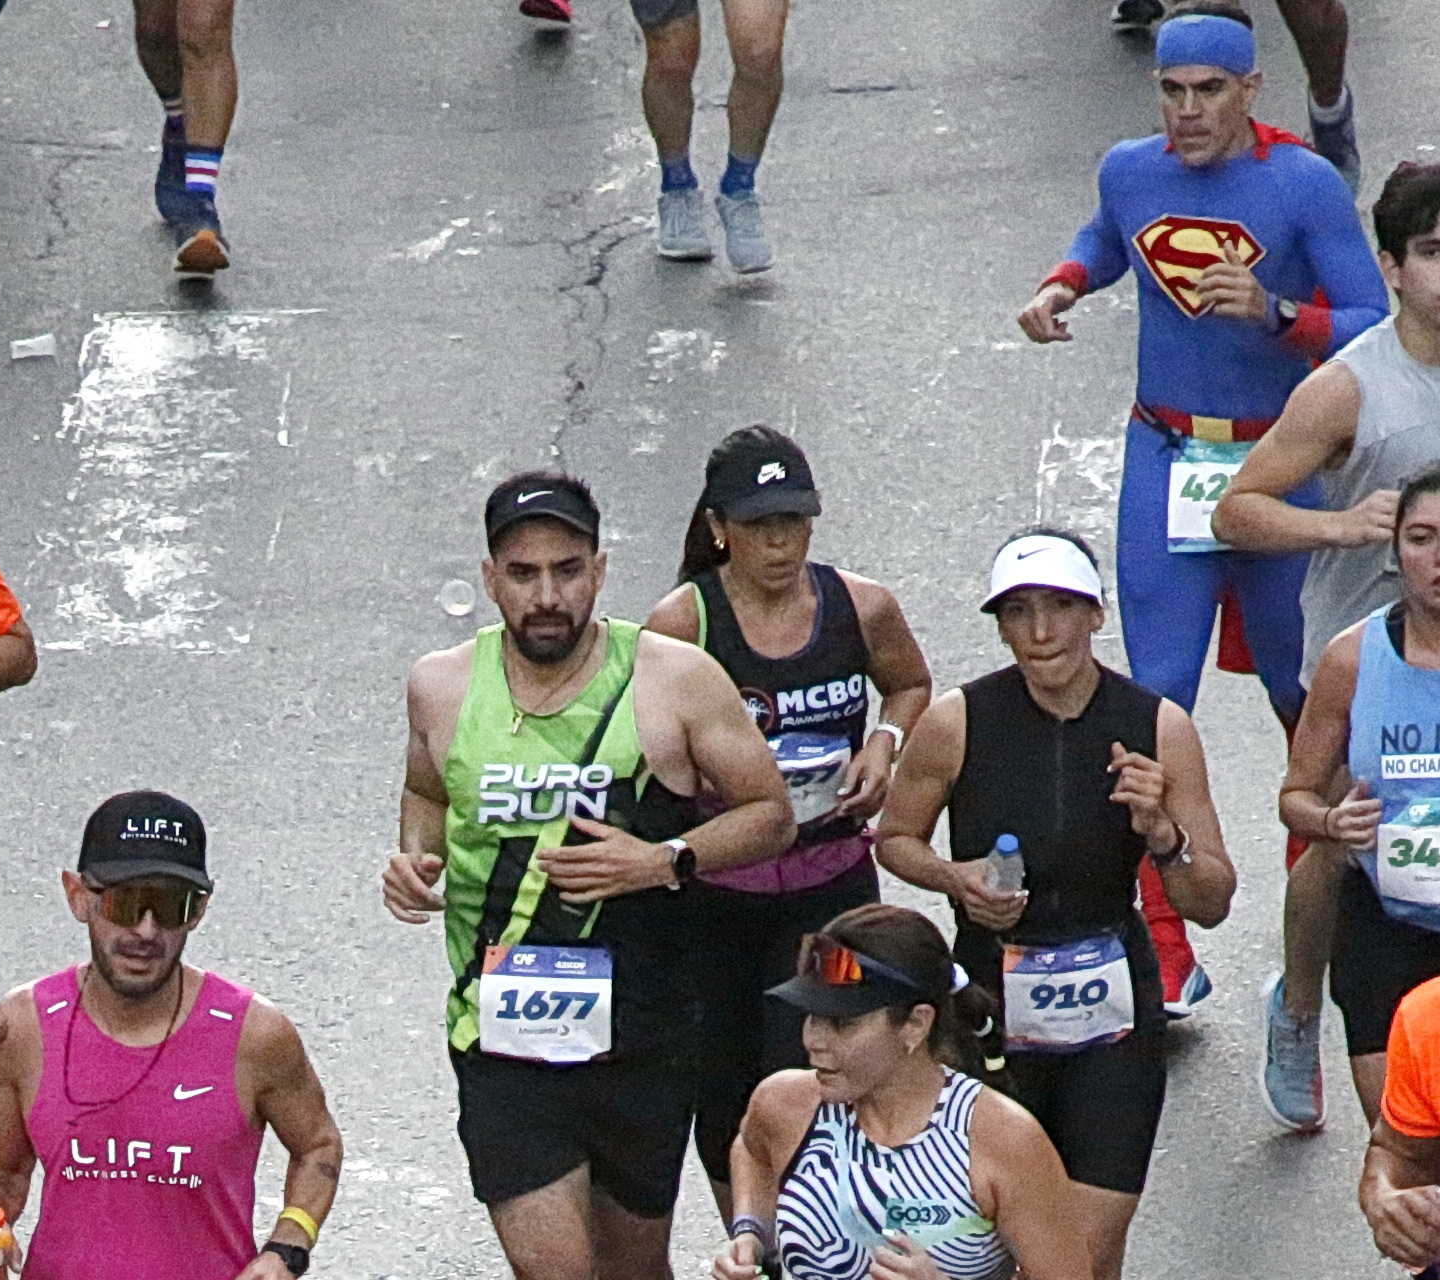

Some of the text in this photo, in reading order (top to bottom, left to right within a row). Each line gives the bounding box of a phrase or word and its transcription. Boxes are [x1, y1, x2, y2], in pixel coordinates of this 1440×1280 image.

[1179, 472, 1237, 502] 42
[776, 673, 863, 715] MCBO
[1380, 722, 1422, 752] NO
[480, 763, 614, 791] PURO
[1384, 757, 1407, 775] NO
[477, 791, 608, 824] RUN
[126, 818, 184, 837] LIFT
[495, 987, 601, 1021] 1677
[1029, 978, 1110, 1011] 910
[70, 1137, 193, 1175] LIFT
[75, 1169, 188, 1186] FITNESS CLUB
